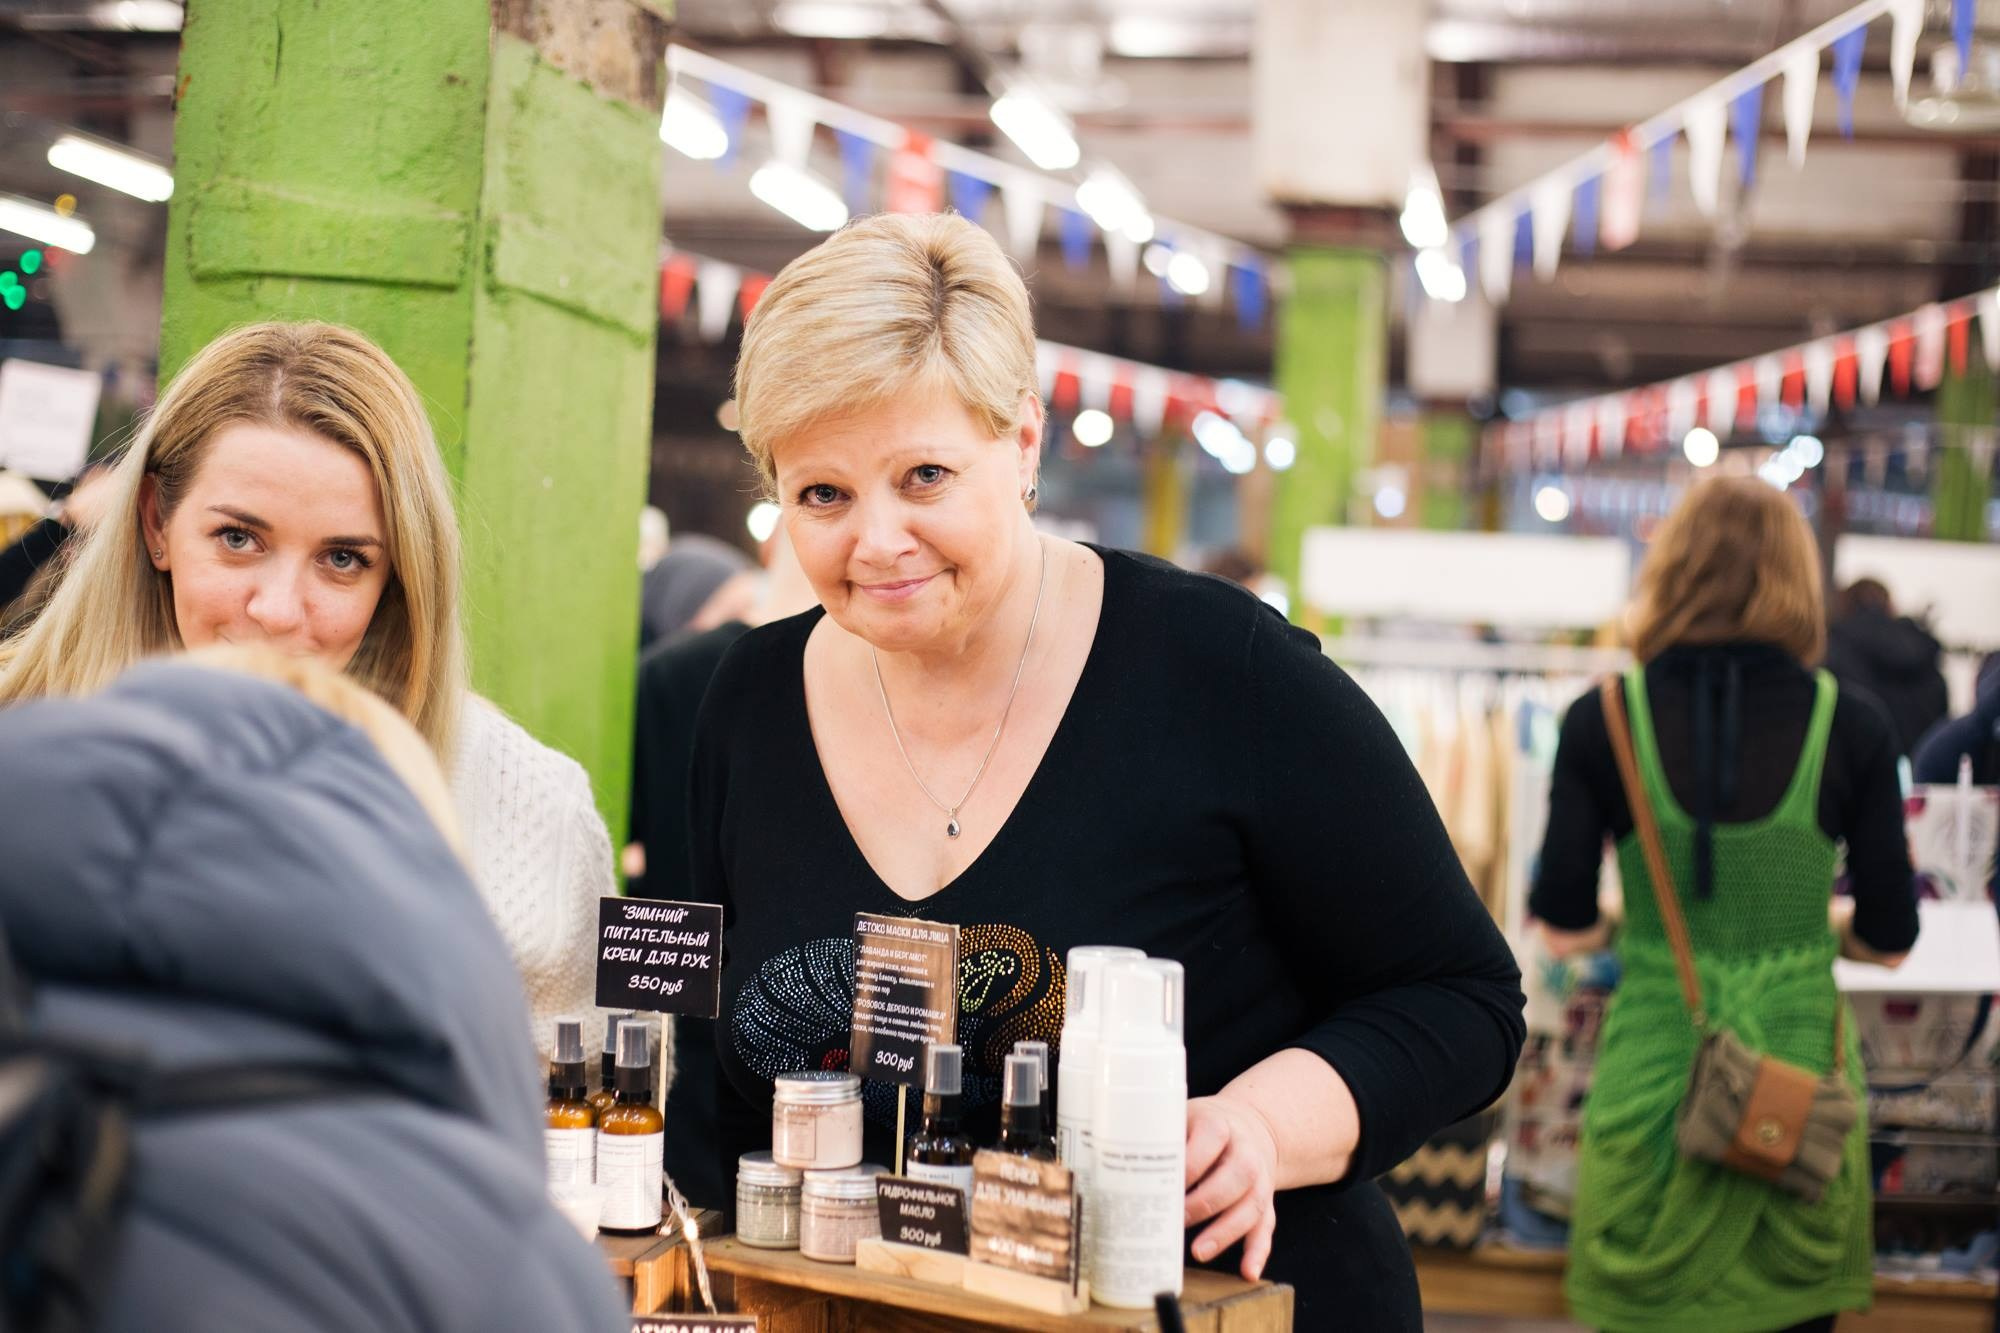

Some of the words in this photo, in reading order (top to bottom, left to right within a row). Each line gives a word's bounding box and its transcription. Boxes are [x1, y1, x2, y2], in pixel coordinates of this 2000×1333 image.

[622, 904, 689, 924] "ЗИМНИЙ"
[603, 925, 710, 948] ПИТАТЕЛЬНЫЙ
[856, 920, 886, 935] ДЕТОКС
[886, 925, 911, 937] МАСКИ
[911, 928, 929, 941] ДЛЯ
[928, 930, 950, 944] ЛИЦА
[602, 946, 643, 963] КРЕМ
[644, 949, 678, 966] ДЛЯ
[680, 952, 711, 969] РУК
[628, 974, 660, 990] 350
[659, 979, 684, 996] руб
[886, 1002, 910, 1014] ДЕРЕВО
[875, 1050, 899, 1066] 300
[897, 1056, 915, 1072] руб
[879, 1183, 957, 1207] ГИДРОФИЛЬНОЕ
[900, 1204, 936, 1220] МАСЛО
[900, 1227, 924, 1242] 300
[924, 1231, 942, 1247] руб
